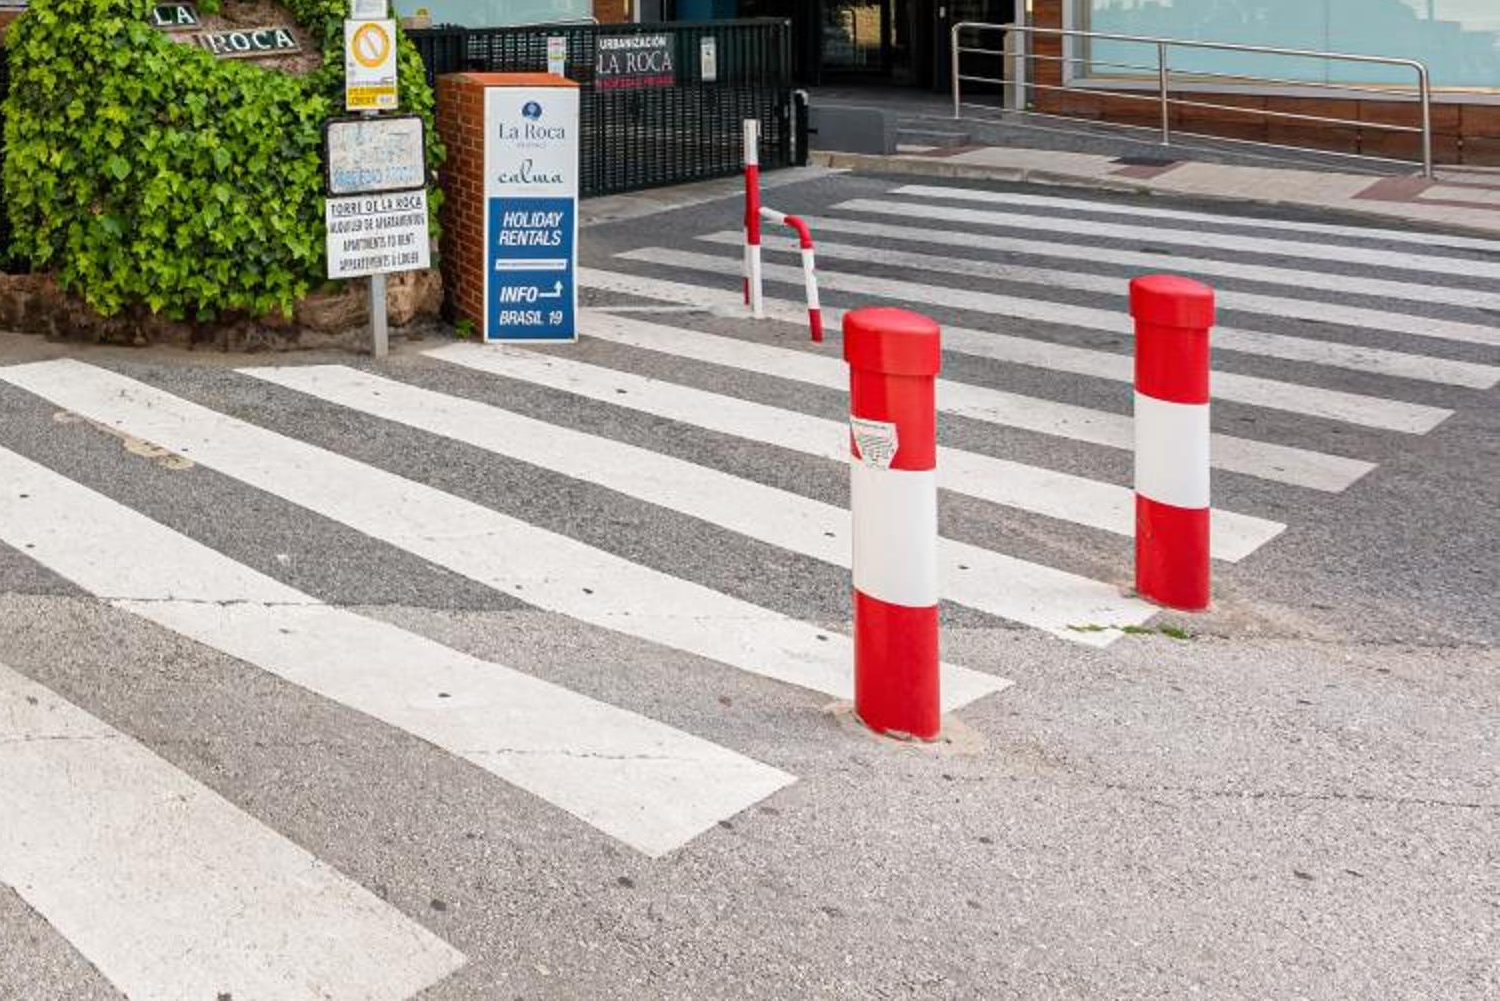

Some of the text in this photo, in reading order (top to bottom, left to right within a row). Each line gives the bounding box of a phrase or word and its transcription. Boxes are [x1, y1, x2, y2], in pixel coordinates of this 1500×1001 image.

[153, 6, 195, 25] LA
[210, 29, 295, 53] ROCA
[597, 51, 673, 74] LA ROCA
[499, 123, 565, 140] La Roca
[497, 158, 564, 184] calma
[382, 198, 392, 210] LA
[396, 196, 422, 209] ROCA
[503, 211, 564, 228] HOLIDAY
[499, 230, 563, 246] RENTALS
[499, 286, 538, 303] INFO
[499, 310, 563, 326] BRASIL 19
